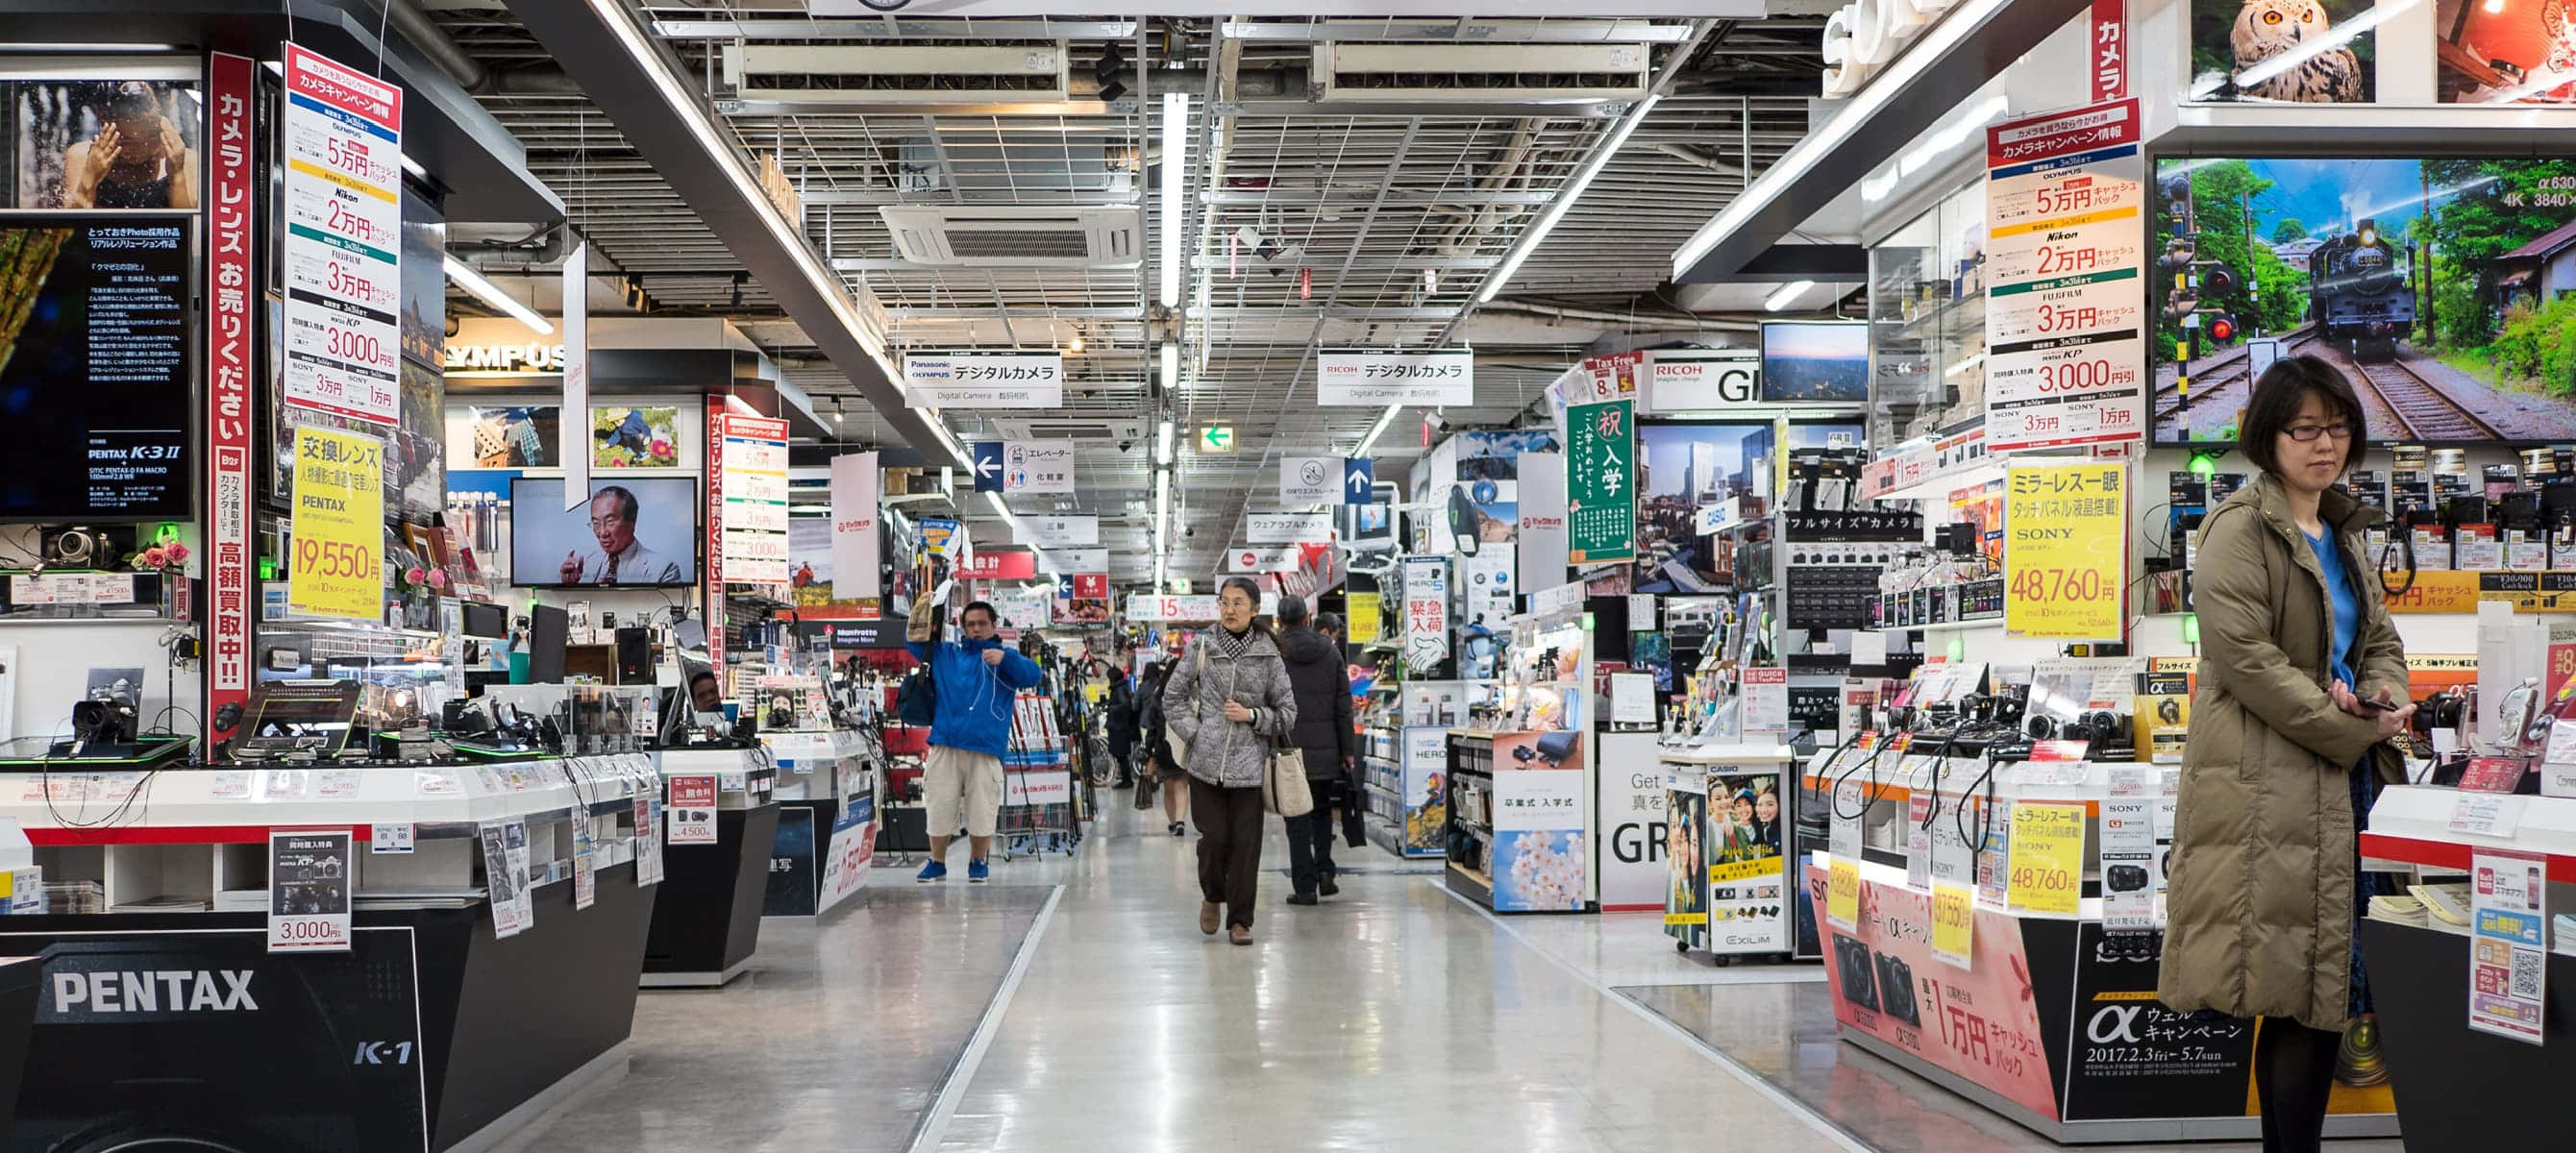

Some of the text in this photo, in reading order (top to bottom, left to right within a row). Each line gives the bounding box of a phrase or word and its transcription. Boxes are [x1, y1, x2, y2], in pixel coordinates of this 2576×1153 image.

[300, 74, 389, 119] カメラキャンペーン情報
[333, 122, 361, 139] OLYMPUS
[2002, 126, 2122, 159] カメラキャンペーン情報
[328, 136, 368, 178] 5万円
[2043, 167, 2082, 180] OLYMPUS
[334, 187, 359, 204] Nikon
[2093, 182, 2137, 196] キャッシュ
[2037, 187, 2092, 214] 5万円
[2093, 195, 2120, 207] バック
[2503, 192, 2566, 208] 4K 3840
[328, 199, 371, 240] 2万円
[2046, 231, 2078, 242] Nikon
[218, 94, 244, 440] カメラ・レンズ お売りください
[2037, 245, 2096, 275] 2万円
[328, 261, 371, 302] 3万円
[2043, 289, 2082, 302] FUJIFILM
[2037, 304, 2096, 332] 3万円
[445, 343, 564, 368] YMPUS
[2063, 349, 2083, 360] KP
[1326, 365, 1358, 374] RICOH
[1364, 364, 1462, 380] デジタルカメラ
[1596, 358, 1613, 369] Tax
[1656, 365, 1702, 376] RICOH
[954, 365, 1054, 380] デジタルカメラ
[2038, 359, 2135, 395] 3,000円引
[316, 373, 342, 397] 3万円
[1350, 389, 1403, 398] Digital Camera
[1718, 369, 1759, 403] G
[937, 391, 961, 401] Digital
[962, 391, 992, 401] Camera
[2068, 403, 2095, 412] SONY
[2099, 407, 2131, 425] 1万円
[1598, 409, 1623, 437] 祝
[2024, 414, 2059, 431] 3万円
[88, 450, 128, 459] PENTAX
[303, 435, 378, 470] 交換レンズ
[1028, 449, 1072, 458] エレベーター
[1601, 444, 1623, 498] 入学
[2014, 470, 2119, 495] ミラーレス一眼
[302, 495, 346, 512] PENTAX
[1253, 521, 1324, 529] ウェアラブルカメラ
[1707, 507, 1726, 526] CASIO
[2017, 527, 2074, 541] SONY
[2428, 586, 2471, 596] キャッシュ
[2427, 597, 2455, 607] バック
[1410, 617, 1443, 632] 入荷
[837, 629, 878, 638] Manfrotto
[2157, 662, 2192, 671] フルサイズ
[1631, 773, 1661, 789] Get
[1542, 798, 1573, 808] 入学式
[53, 970, 259, 1014] PENTAX
[1931, 978, 1991, 1067] 1万円
[2087, 1004, 2143, 1043] α
[1990, 1020, 2039, 1058] キャッシュ
[2144, 1024, 2242, 1042] キャンペーン
[353, 1041, 412, 1066] K-1
[1995, 1050, 2023, 1077] バック
